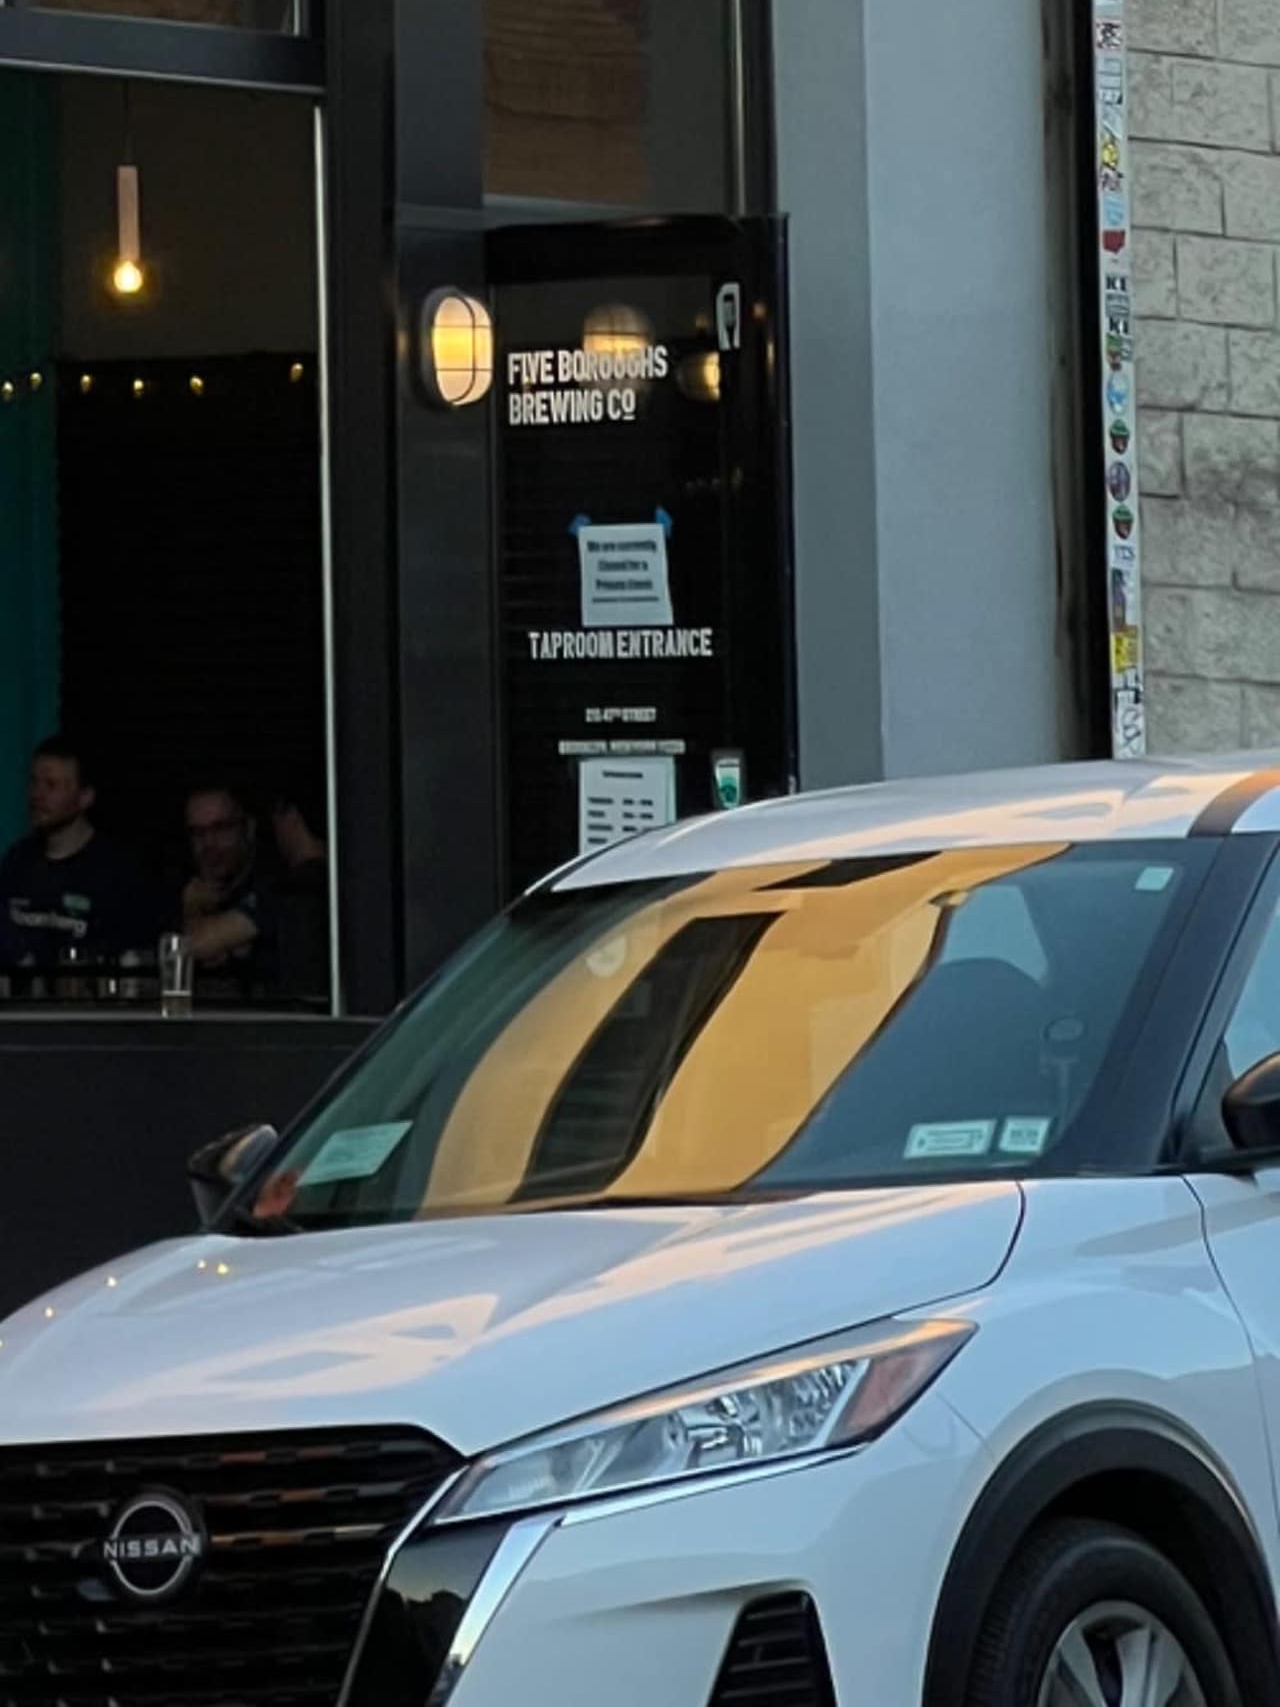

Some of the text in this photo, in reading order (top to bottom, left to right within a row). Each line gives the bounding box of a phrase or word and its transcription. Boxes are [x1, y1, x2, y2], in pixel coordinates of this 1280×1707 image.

[507, 344, 669, 386] FIVE BOROUGHS
[508, 388, 604, 426] BREWING
[528, 627, 714, 660] TAPROOM ENTRANCE
[103, 1533, 201, 1559] NISSAN
